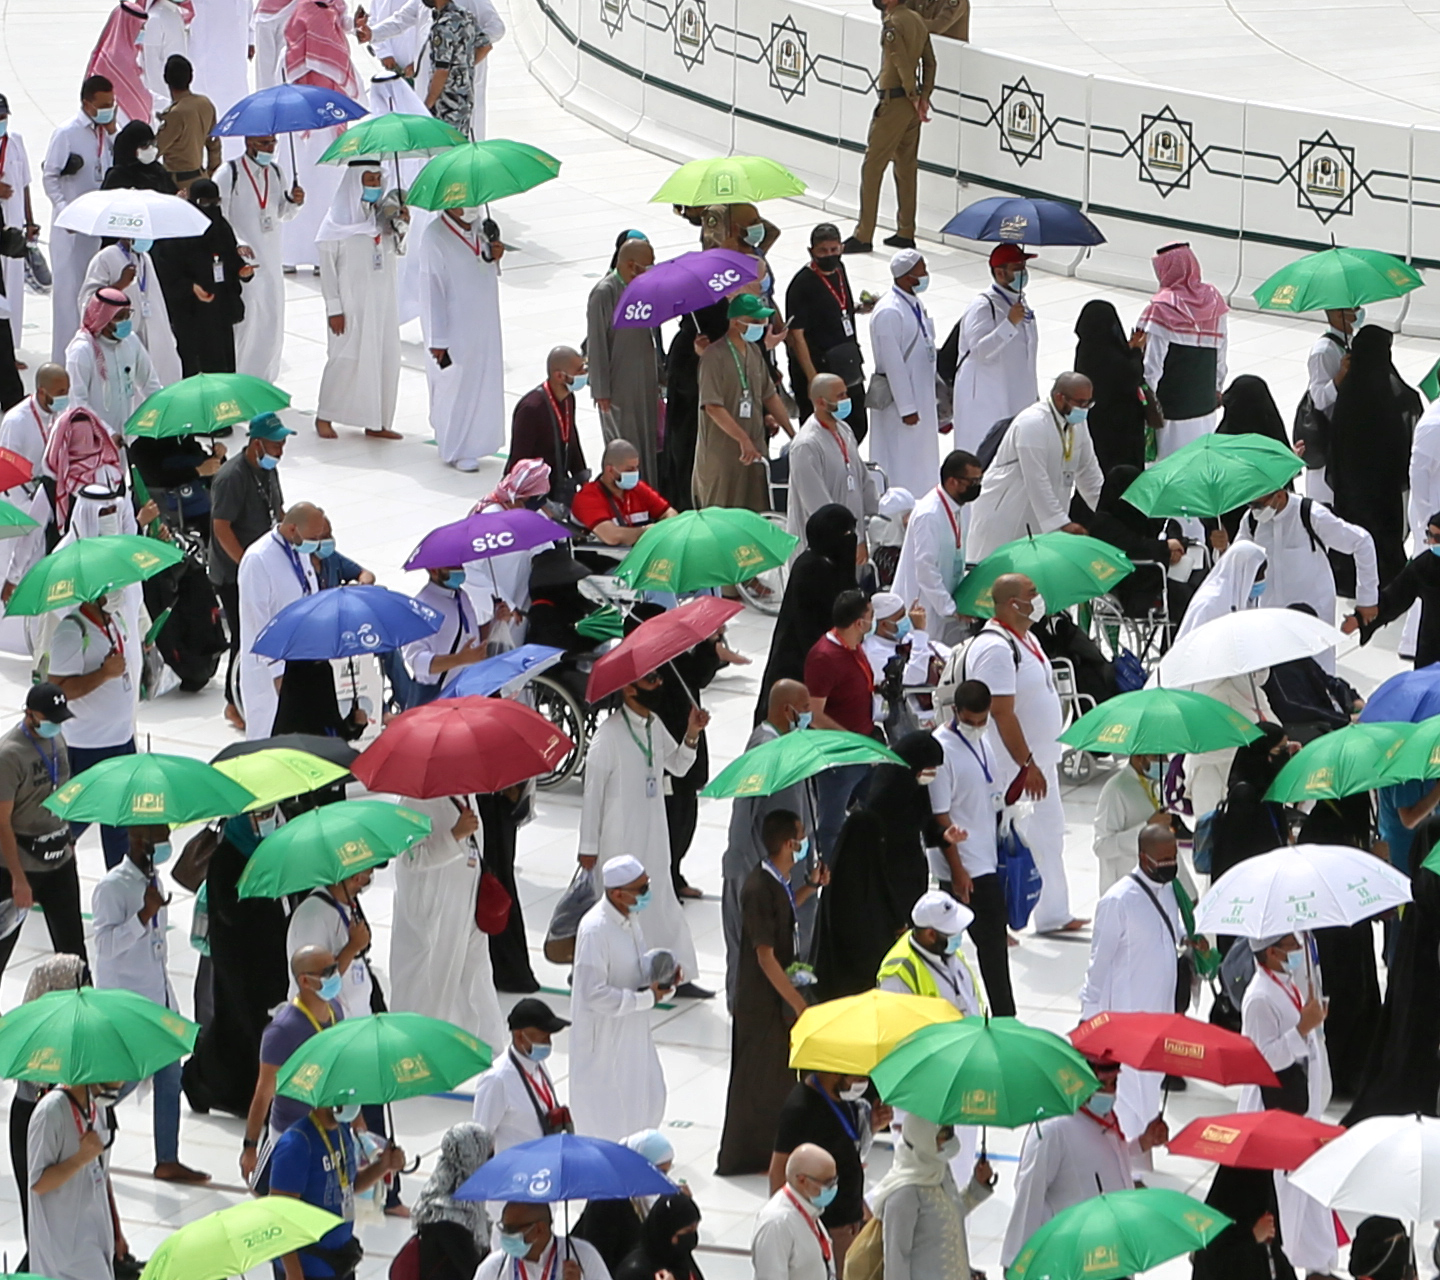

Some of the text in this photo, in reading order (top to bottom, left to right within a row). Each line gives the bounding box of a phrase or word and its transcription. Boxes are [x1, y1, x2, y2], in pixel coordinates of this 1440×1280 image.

[708, 268, 743, 293] stc
[625, 301, 652, 320] stc
[472, 529, 514, 552] stc
